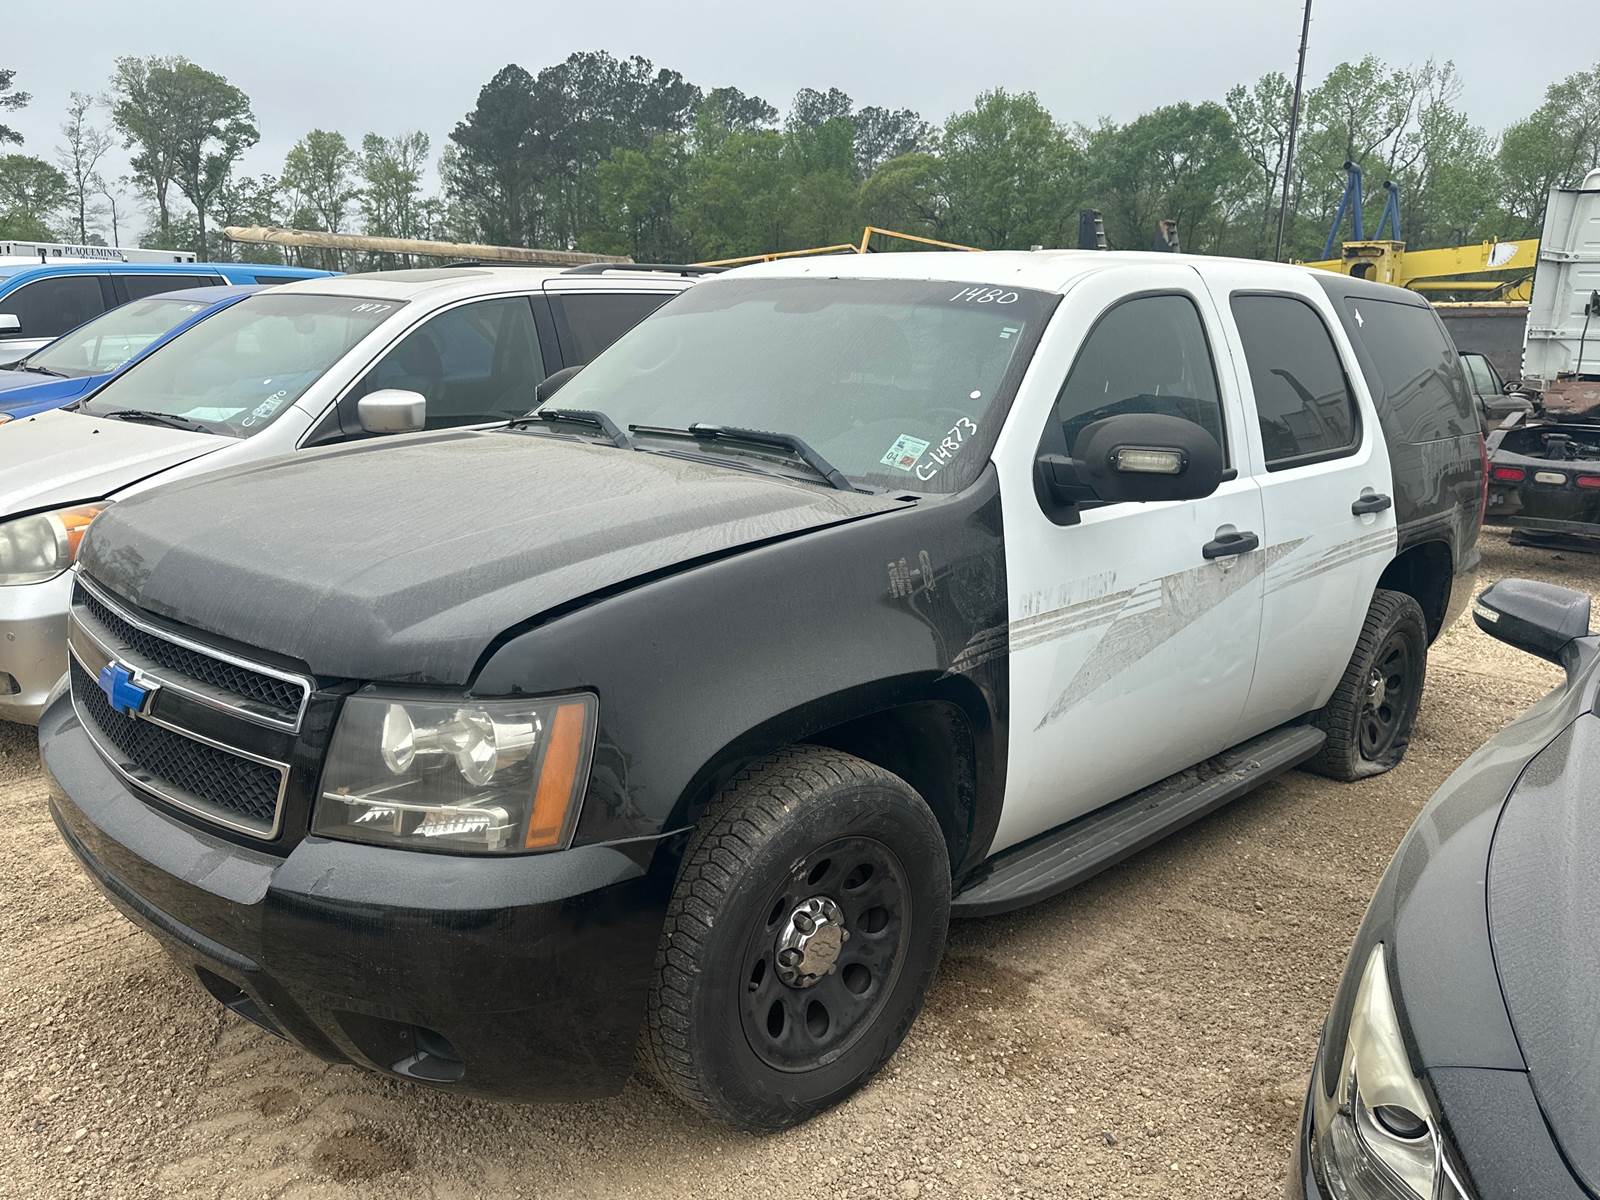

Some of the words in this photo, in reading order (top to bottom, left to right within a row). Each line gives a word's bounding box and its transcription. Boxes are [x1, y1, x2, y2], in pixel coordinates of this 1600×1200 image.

[64, 246, 123, 258] PLAQUEMINES
[949, 287, 1019, 304] 1480
[915, 416, 978, 481] C-14873
